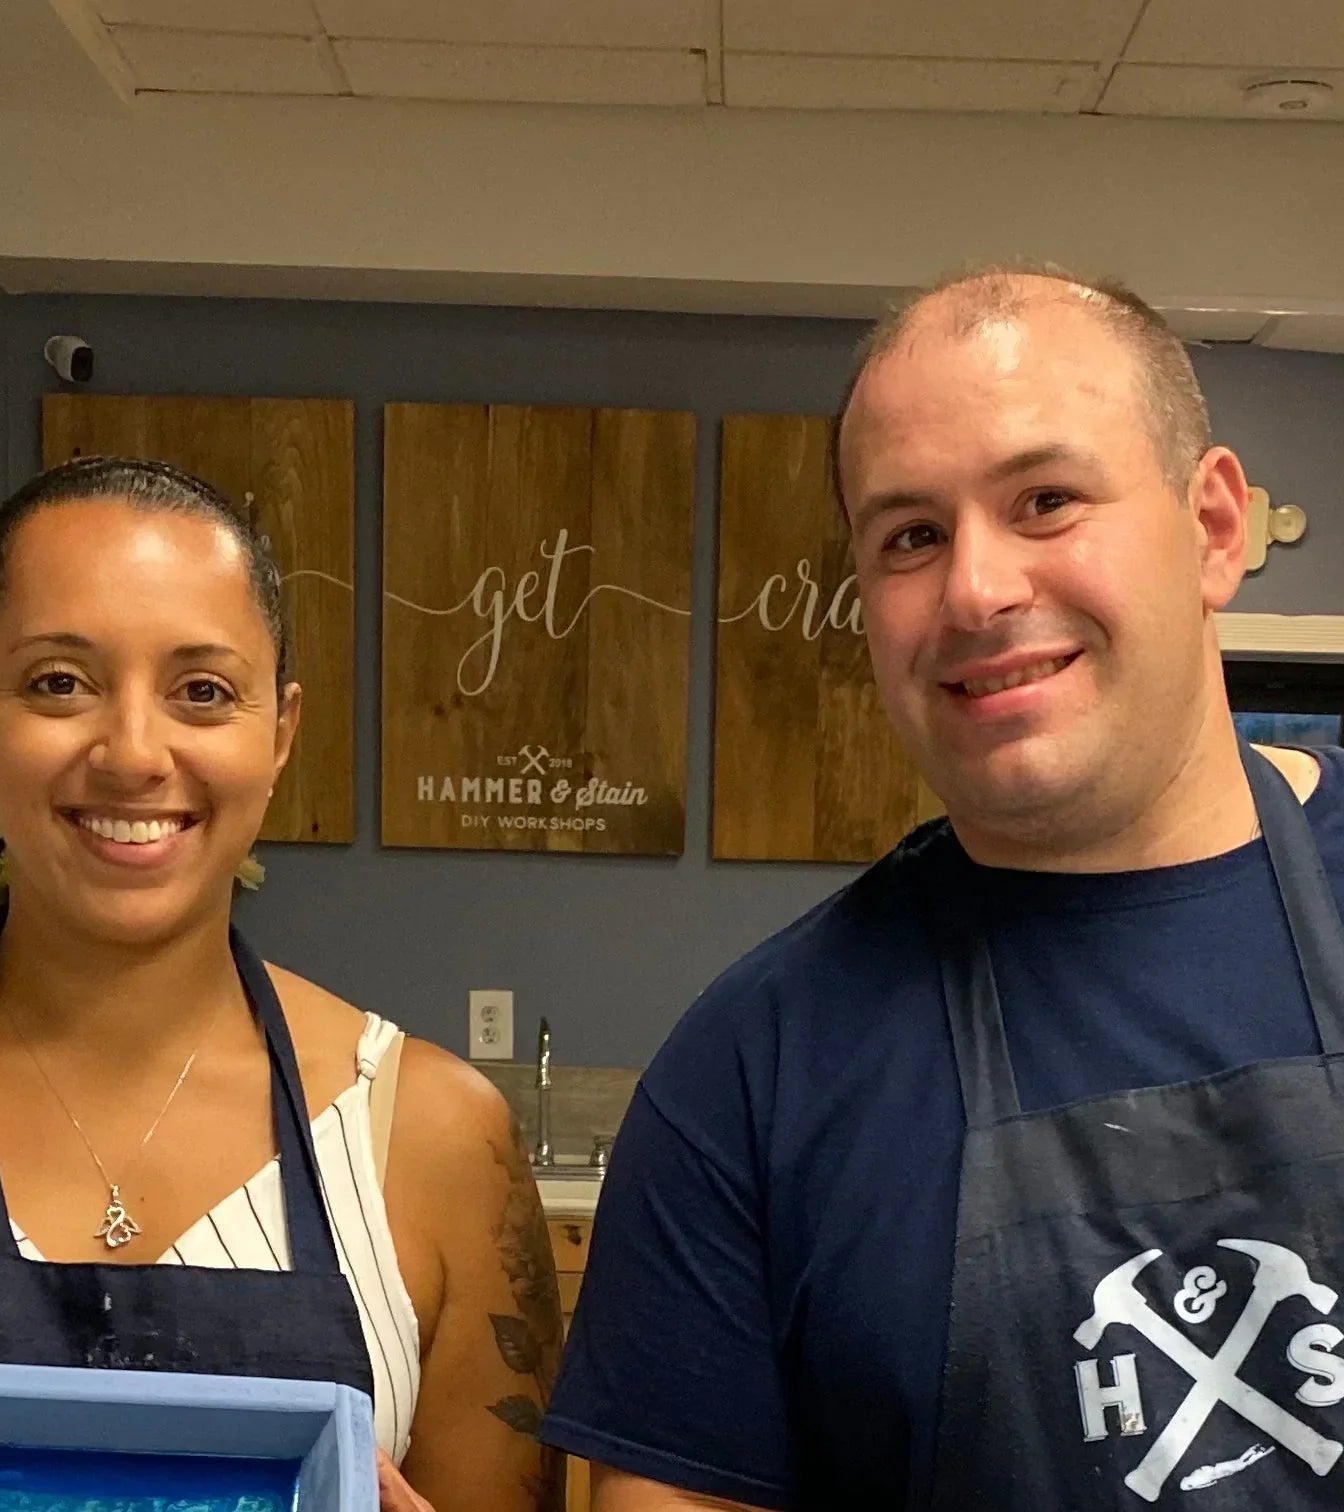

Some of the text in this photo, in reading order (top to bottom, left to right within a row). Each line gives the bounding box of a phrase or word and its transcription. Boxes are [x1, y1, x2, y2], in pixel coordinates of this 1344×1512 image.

[456, 528, 596, 696] get
[497, 756, 518, 766] EST
[417, 775, 649, 811] HAMMER & Stain
[461, 814, 607, 831] DIY WORKSHOPS
[1073, 1353, 1148, 1442] H
[1173, 1265, 1228, 1324] &
